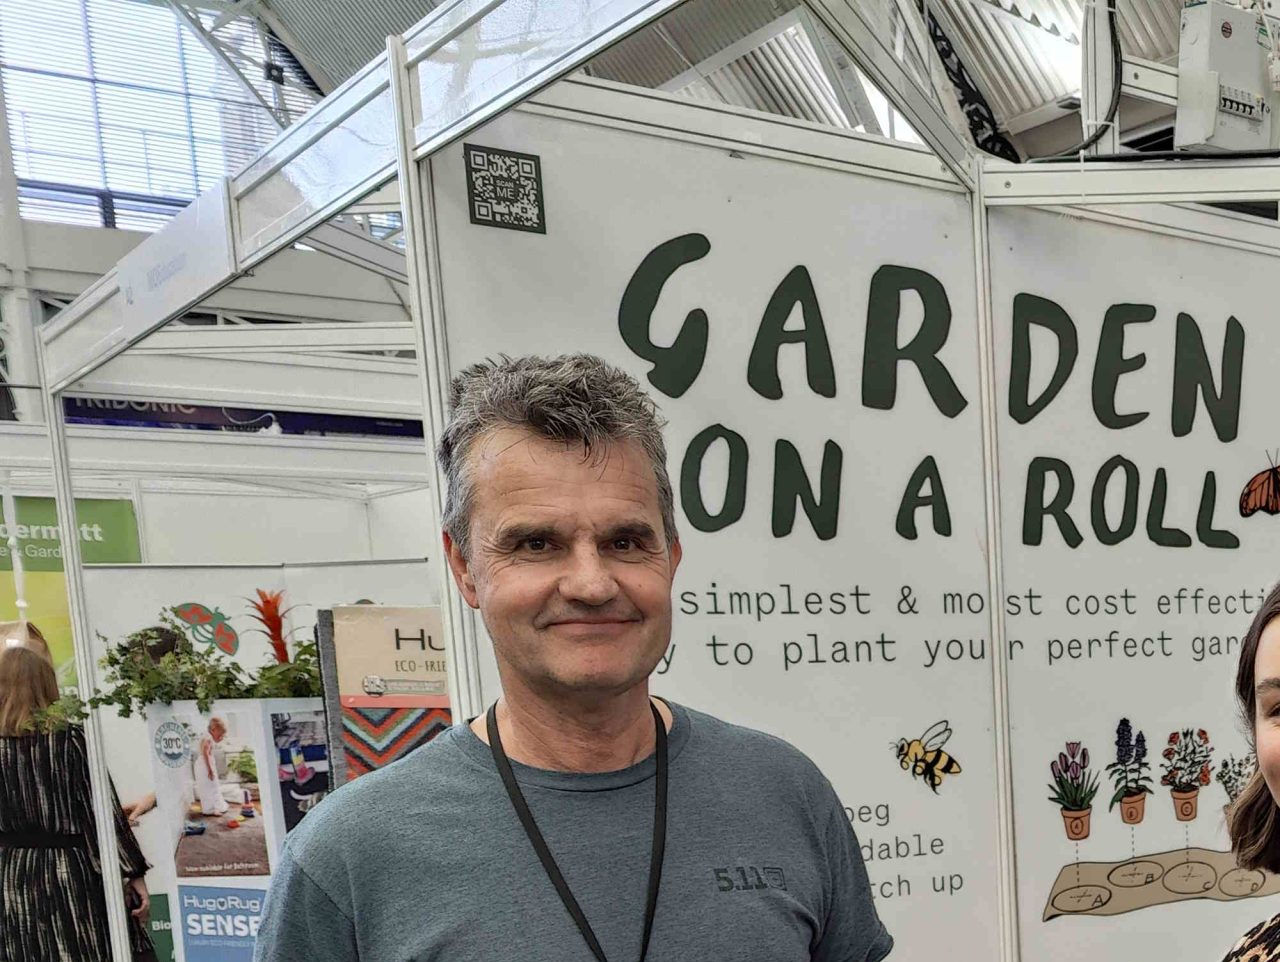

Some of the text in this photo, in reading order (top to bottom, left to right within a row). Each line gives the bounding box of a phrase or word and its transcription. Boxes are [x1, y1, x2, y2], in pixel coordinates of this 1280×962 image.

[497, 187, 515, 199] ME
[618, 232, 1245, 443] GARDEN
[680, 423, 1240, 549] ON A ROLL
[680, 582, 871, 621] simplest
[897, 585, 919, 614] &
[943, 587, 1042, 615] most
[1066, 588, 1137, 616] cost
[706, 635, 753, 665] to
[783, 633, 896, 671] plant
[1048, 631, 1173, 665] perfect
[932, 873, 963, 896] up
[1091, 895, 1105, 906] A
